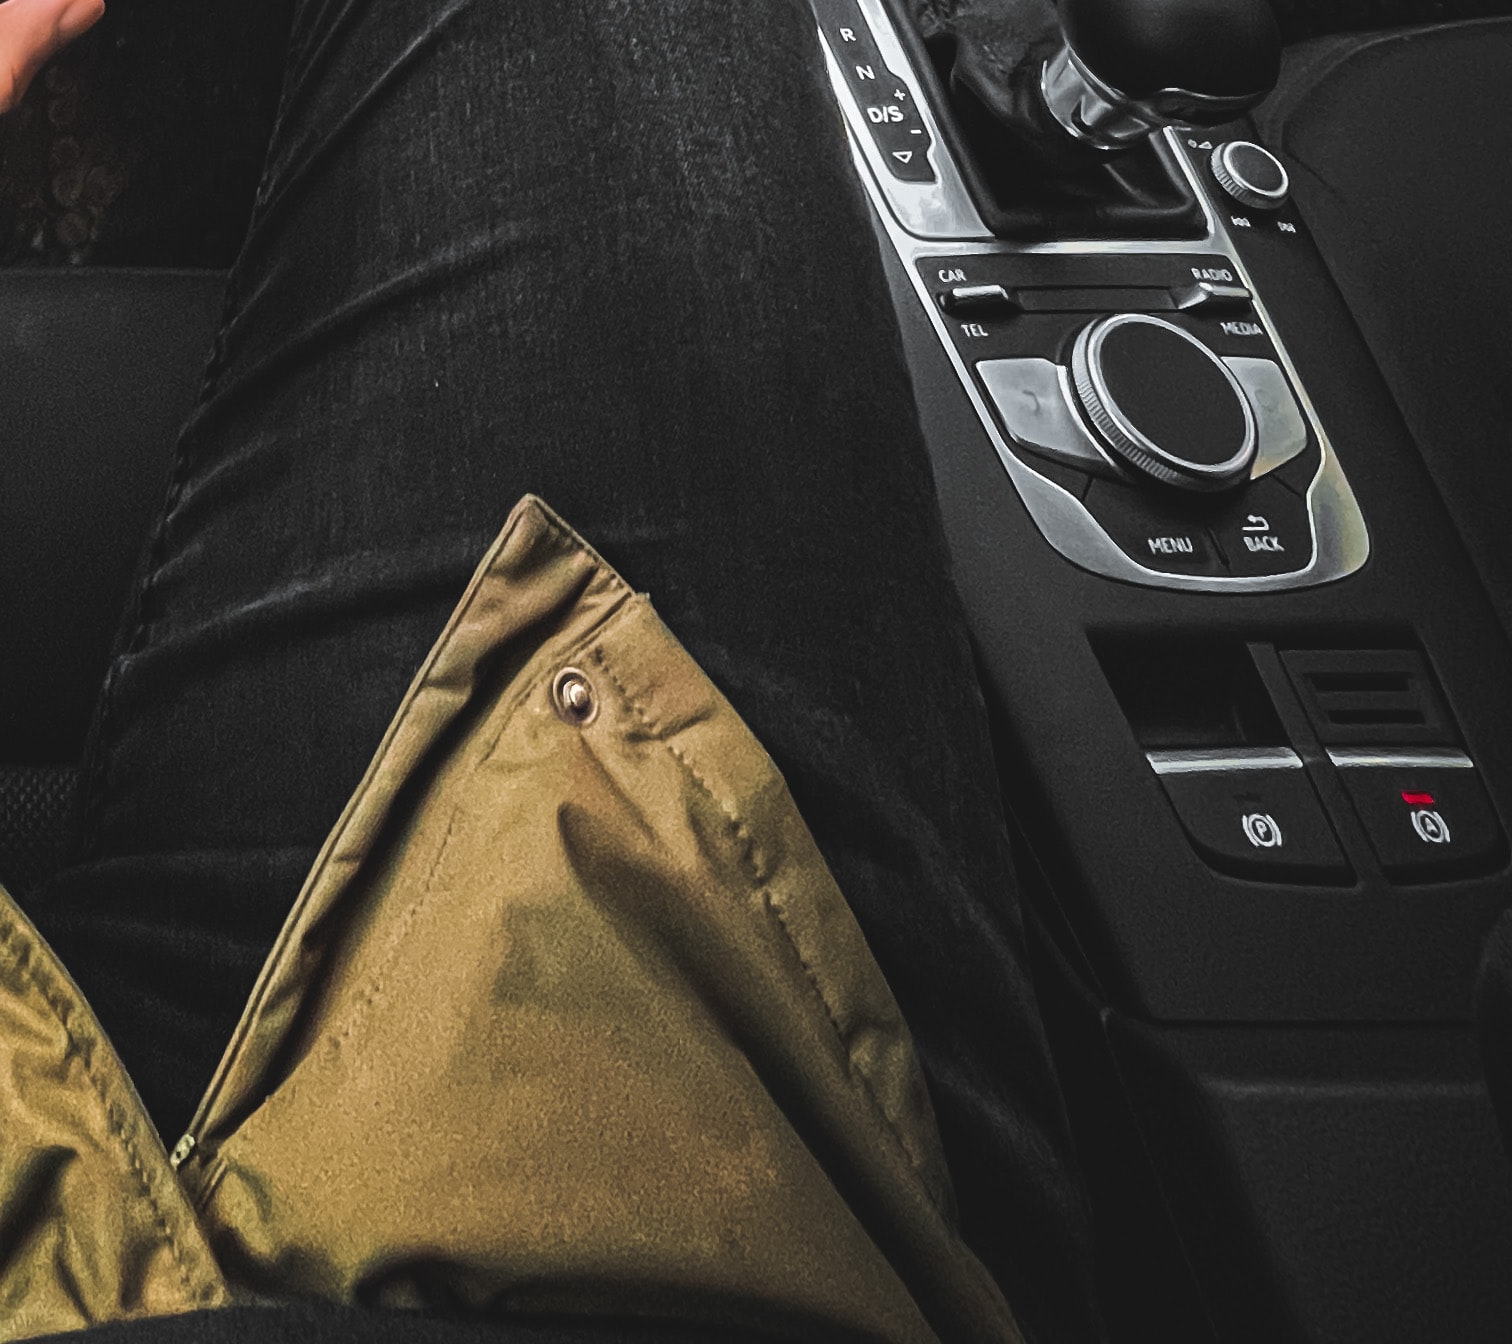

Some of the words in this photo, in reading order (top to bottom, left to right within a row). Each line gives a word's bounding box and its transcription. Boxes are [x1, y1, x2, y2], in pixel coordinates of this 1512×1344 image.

[839, 27, 857, 42] R
[855, 64, 876, 80] N
[866, 105, 904, 123] D/S
[938, 268, 967, 283] CAR
[1191, 267, 1233, 282] RADIO
[960, 324, 989, 338] TEL
[1220, 322, 1264, 336] MEDIA
[1147, 537, 1193, 554] MENU
[1243, 535, 1285, 552] BACK
